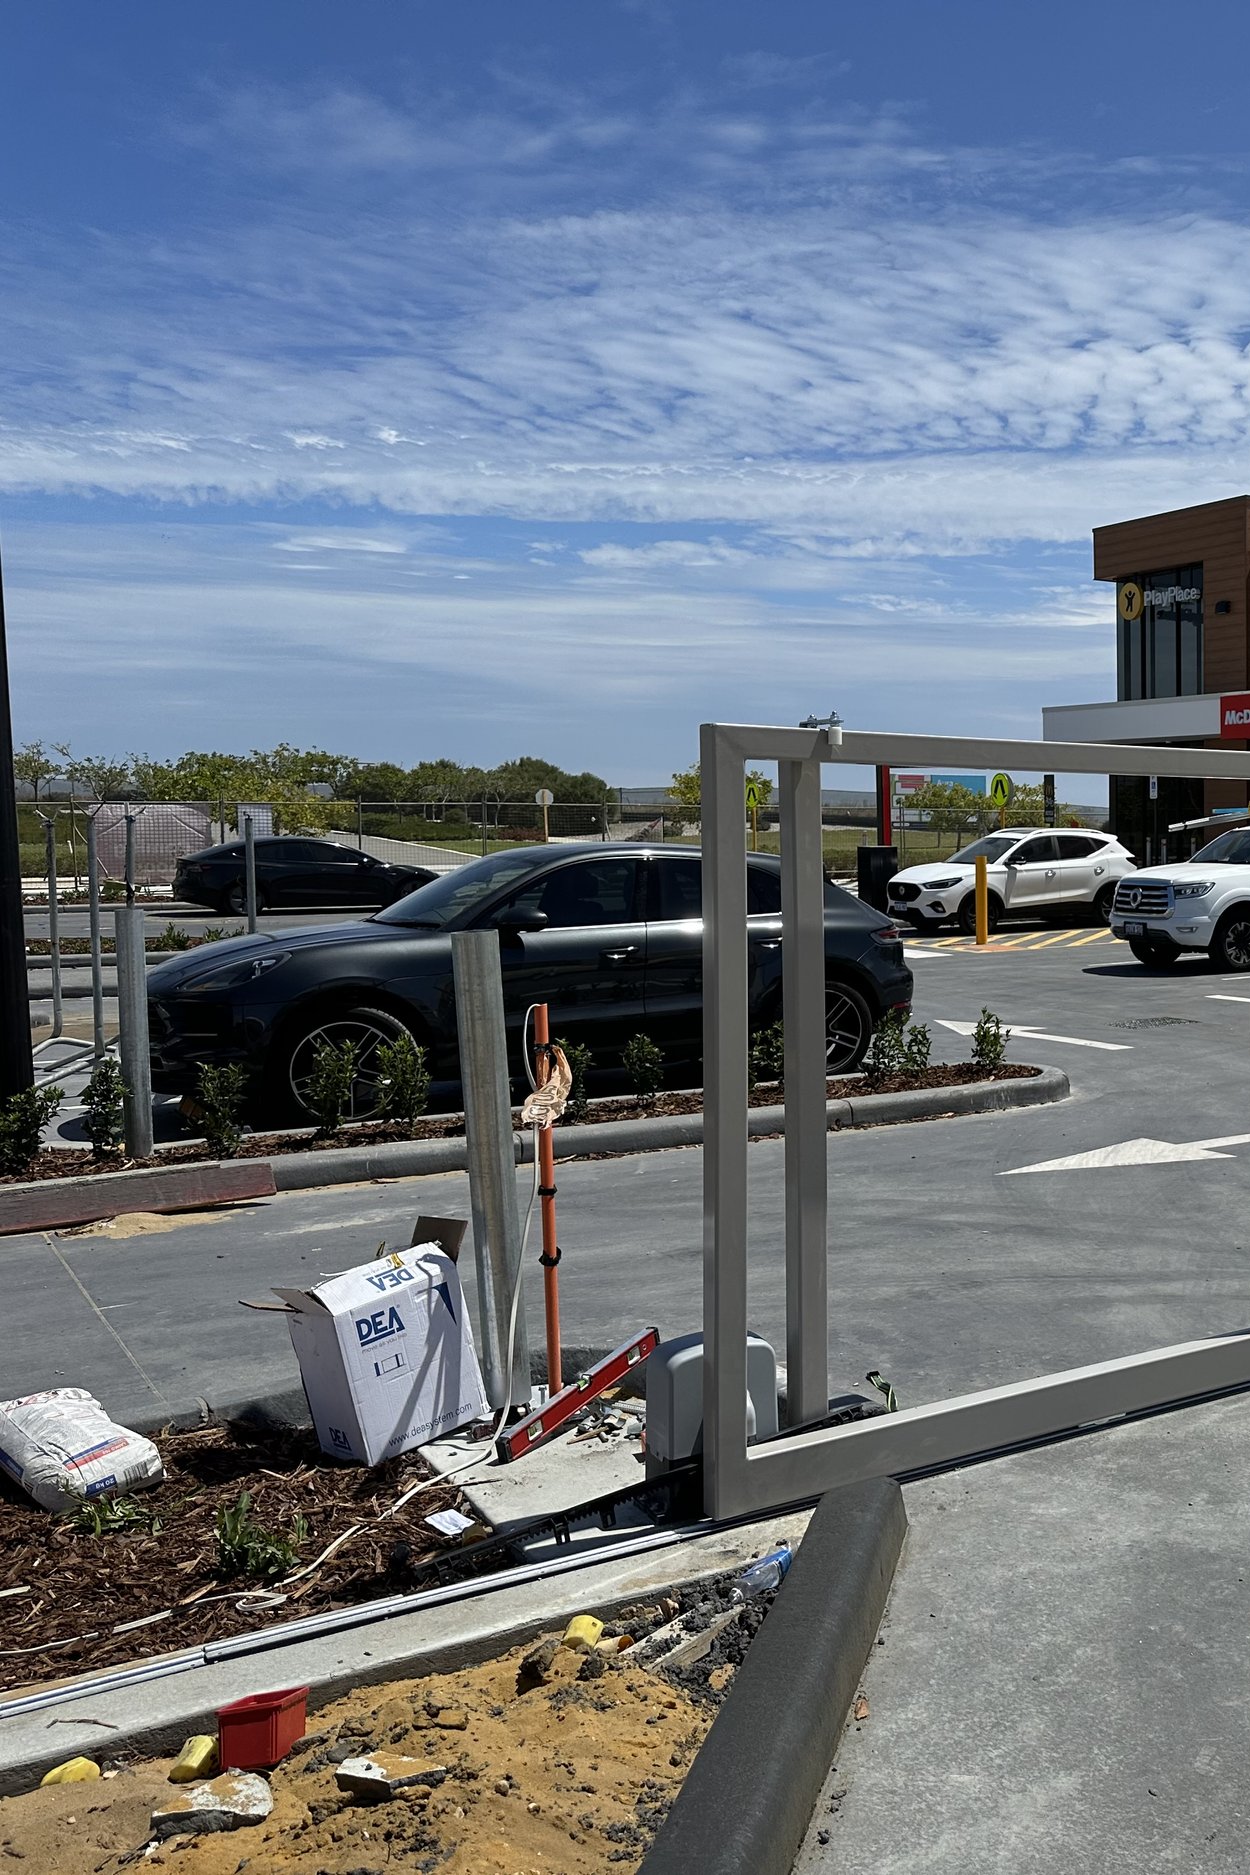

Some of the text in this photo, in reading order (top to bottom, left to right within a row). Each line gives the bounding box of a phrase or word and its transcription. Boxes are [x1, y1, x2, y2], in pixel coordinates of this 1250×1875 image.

[1143, 585, 1198, 607] PlayPlace
[366, 1267, 415, 1292] DEA
[355, 1306, 406, 1341] DEA
[388, 1402, 473, 1447] www.deasystem.com
[328, 1427, 352, 1450] DEA
